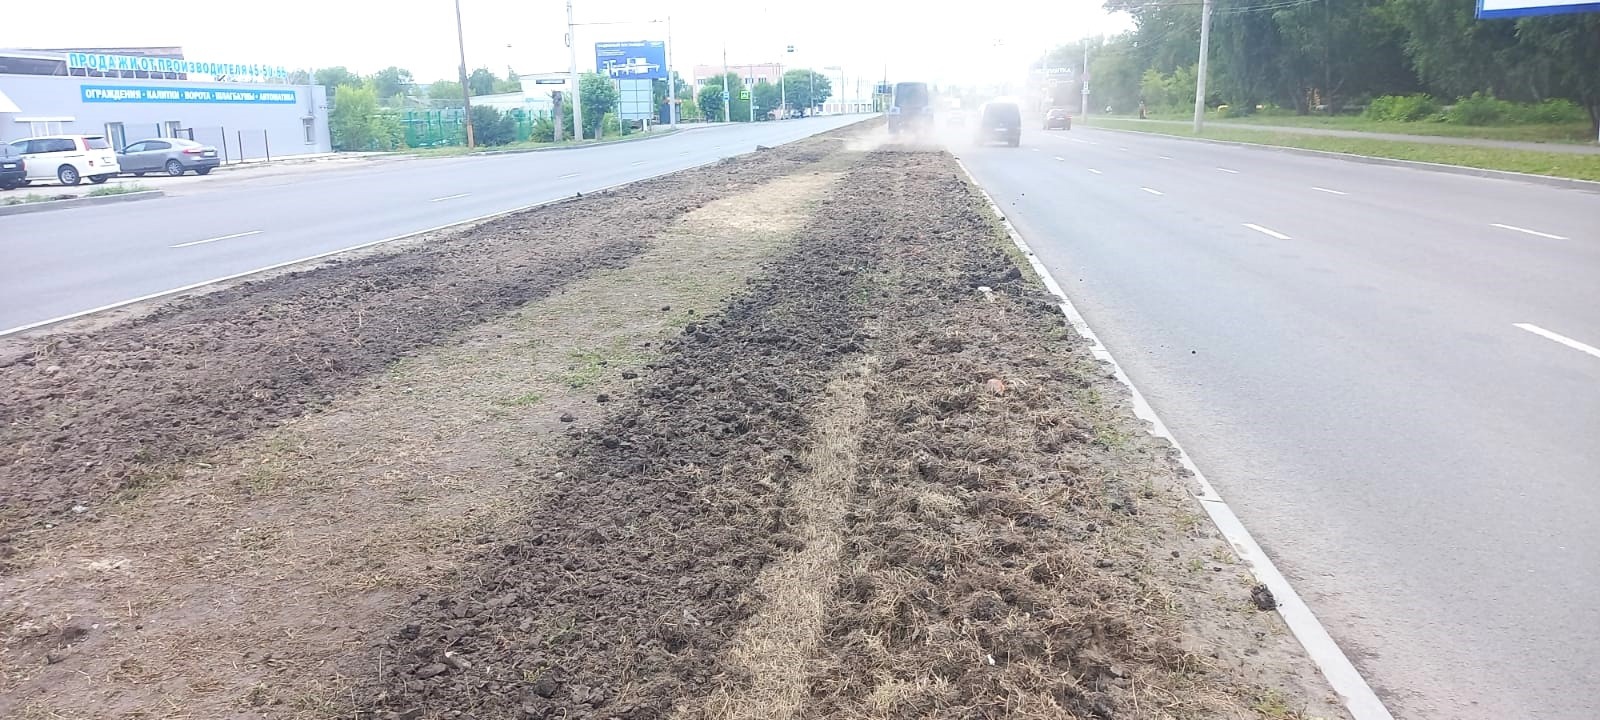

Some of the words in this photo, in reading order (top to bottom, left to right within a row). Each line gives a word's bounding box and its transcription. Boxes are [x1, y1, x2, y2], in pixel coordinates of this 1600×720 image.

[69, 53, 138, 71] ПРОДАЖИ
[141, 57, 155, 70] ОТ
[157, 58, 246, 75] ПРОИЗВОДИТЕЛЯ
[85, 88, 141, 100] ОГРАЖДЕНИЯ
[146, 89, 180, 100] КАЛИТКИ
[184, 90, 211, 101] ВОРОТА
